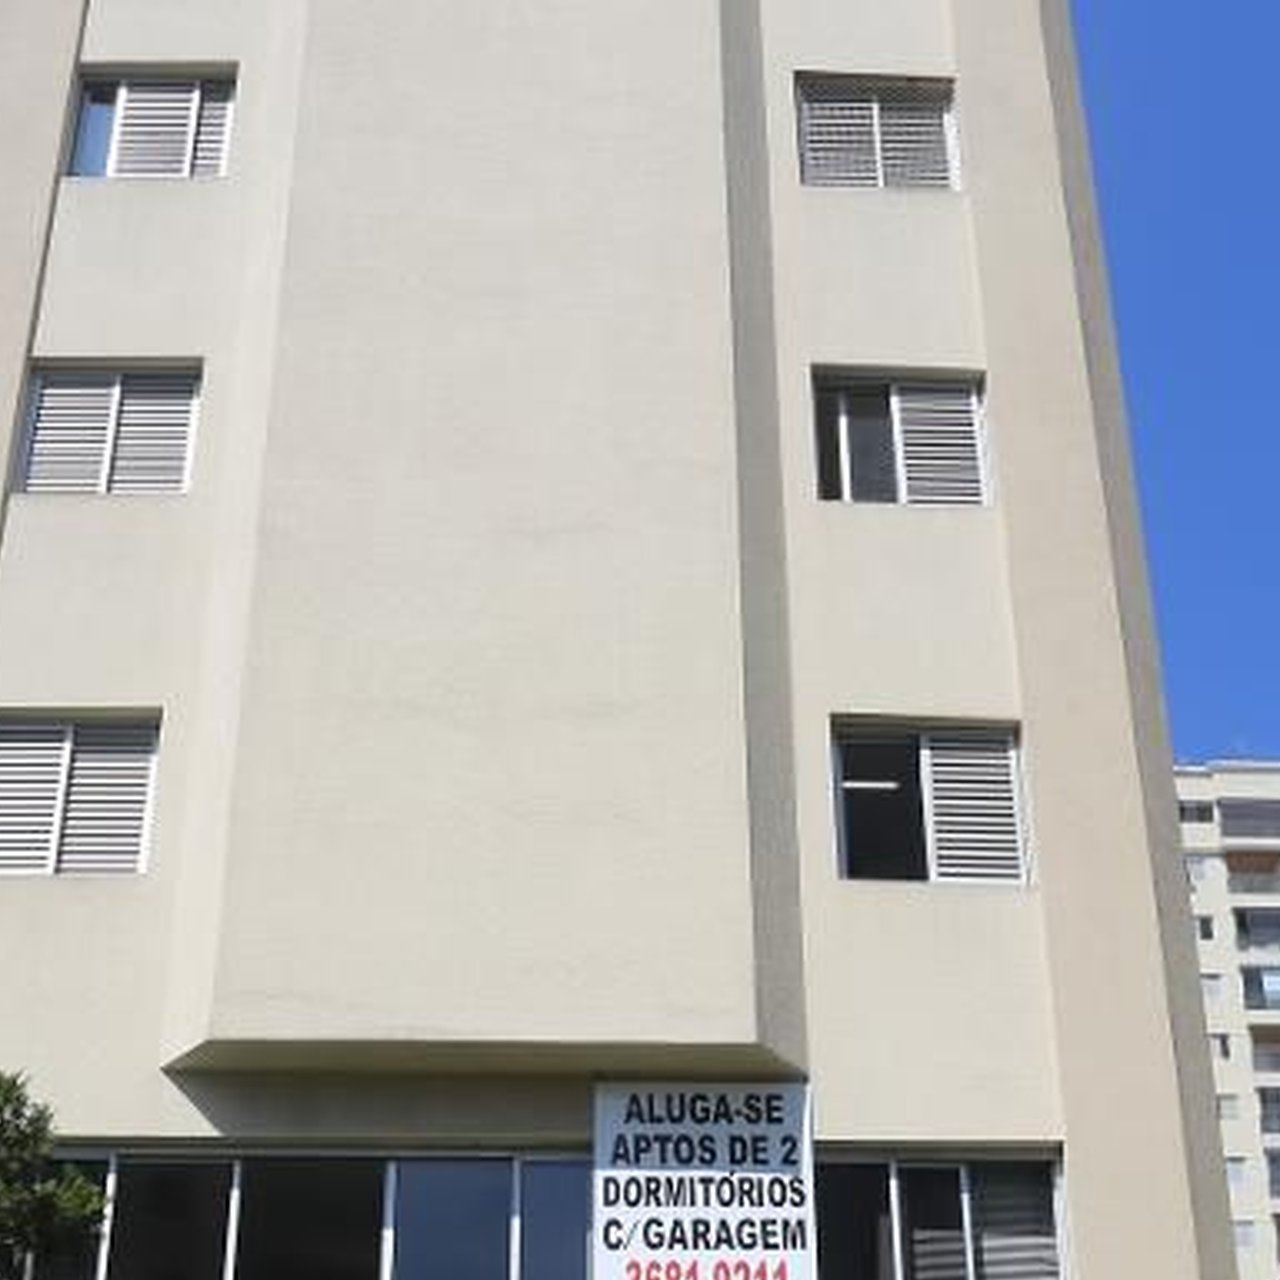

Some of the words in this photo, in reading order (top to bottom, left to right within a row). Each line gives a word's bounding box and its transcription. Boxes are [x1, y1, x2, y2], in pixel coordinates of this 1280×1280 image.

[624, 1093, 784, 1124] ALUGA-SE
[611, 1134, 716, 1165] APTOS
[729, 1135, 770, 1165] DE
[781, 1136, 798, 1165] 2
[602, 1171, 806, 1207] DORMITÓRIOS
[643, 1218, 806, 1250] GARAGEM
